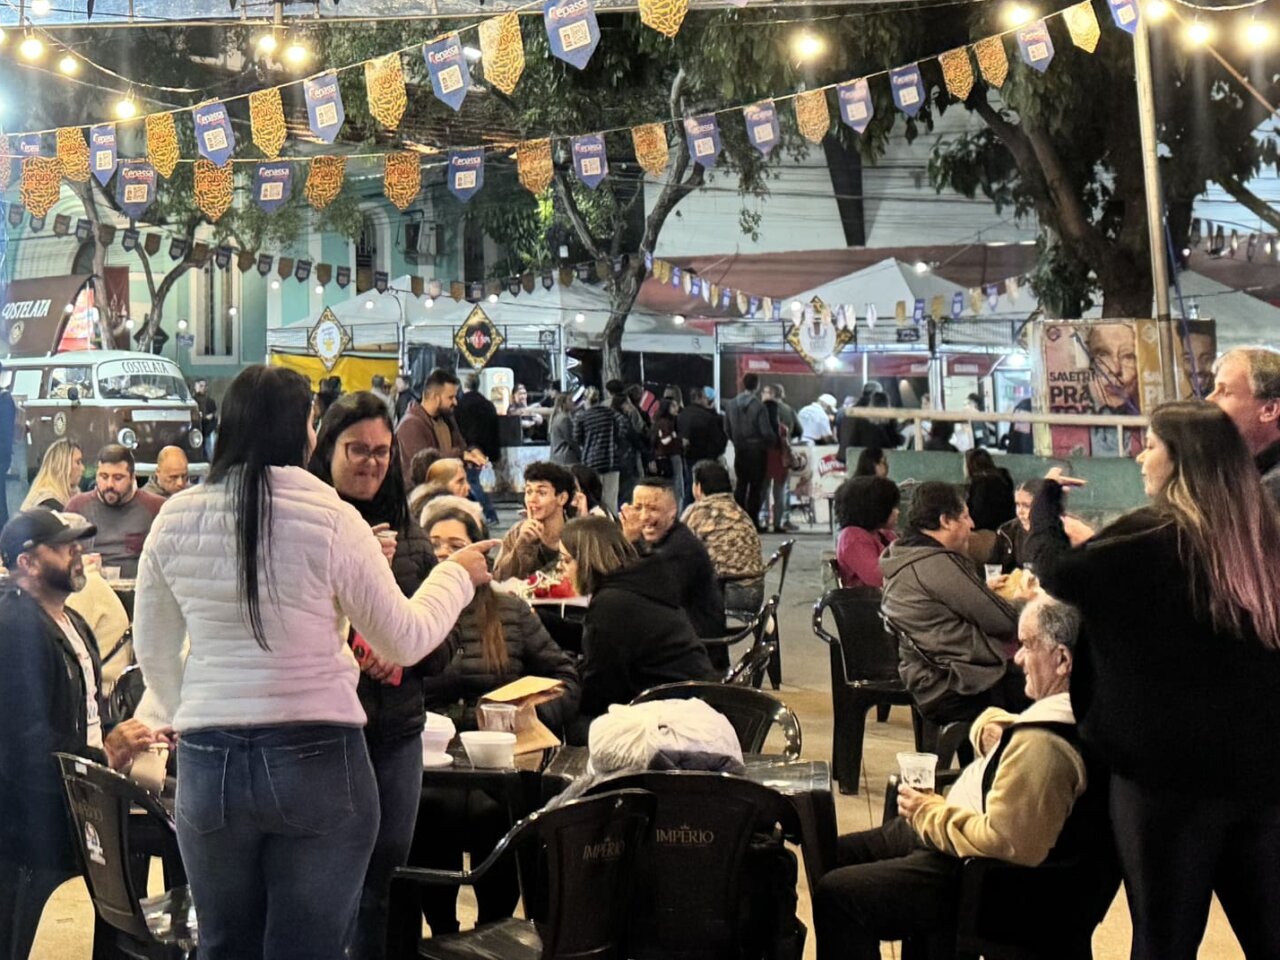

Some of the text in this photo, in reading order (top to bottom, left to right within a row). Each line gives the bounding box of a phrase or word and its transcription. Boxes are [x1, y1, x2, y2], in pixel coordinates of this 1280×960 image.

[429, 45, 459, 64] Repassa
[122, 167, 154, 179] Repassa
[2, 298, 52, 320] COSTELATA
[121, 360, 168, 375] COSTELATA
[1049, 384, 1095, 404] PRA
